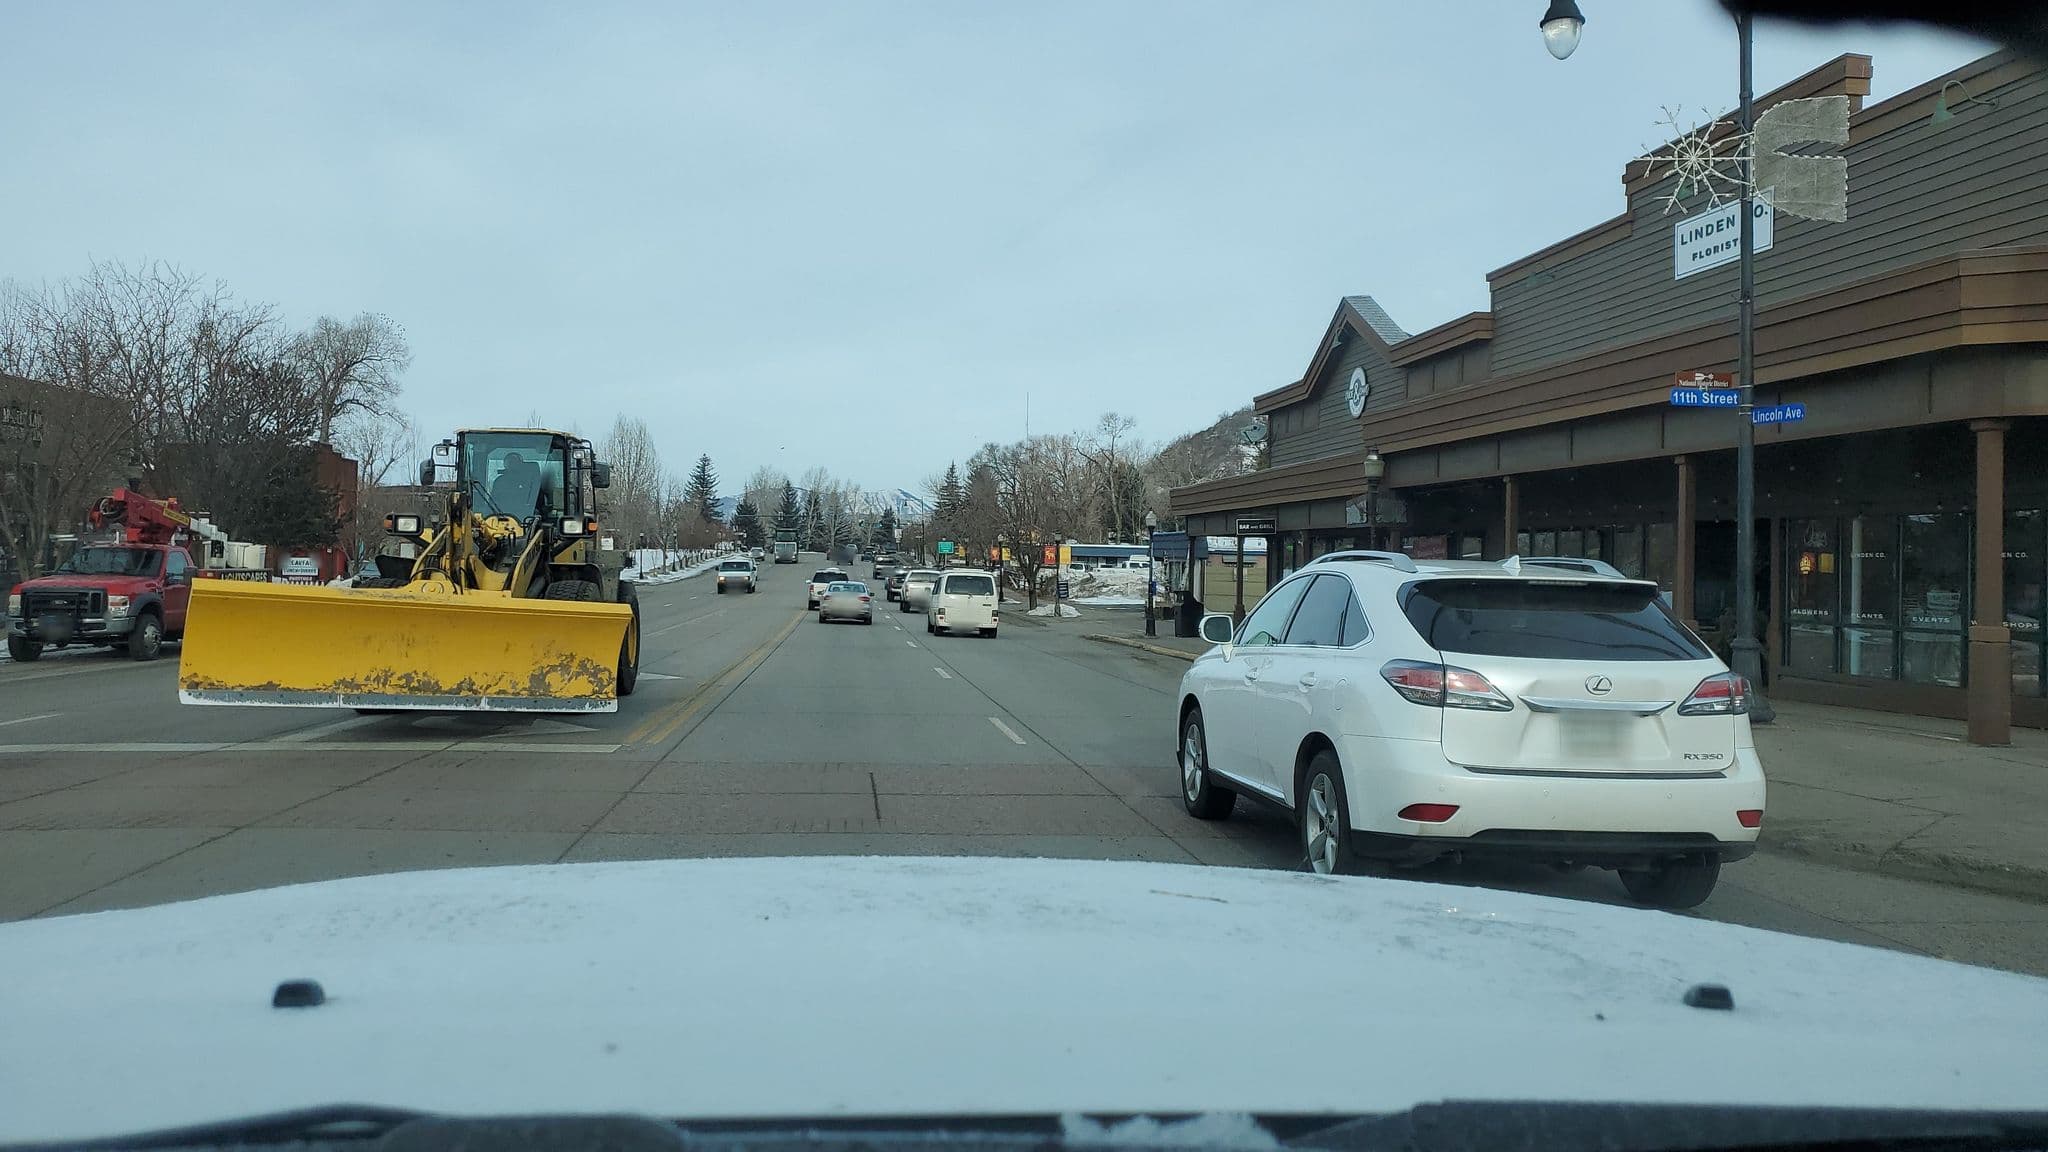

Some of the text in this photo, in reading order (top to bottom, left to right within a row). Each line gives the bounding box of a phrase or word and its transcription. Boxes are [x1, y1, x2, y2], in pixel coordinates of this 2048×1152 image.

[1680, 204, 1769, 246] LINDEN O.
[1692, 238, 1740, 261] FLORIST
[1672, 391, 1738, 405] 11th Street
[1752, 406, 1804, 423] Lincoln Ave.
